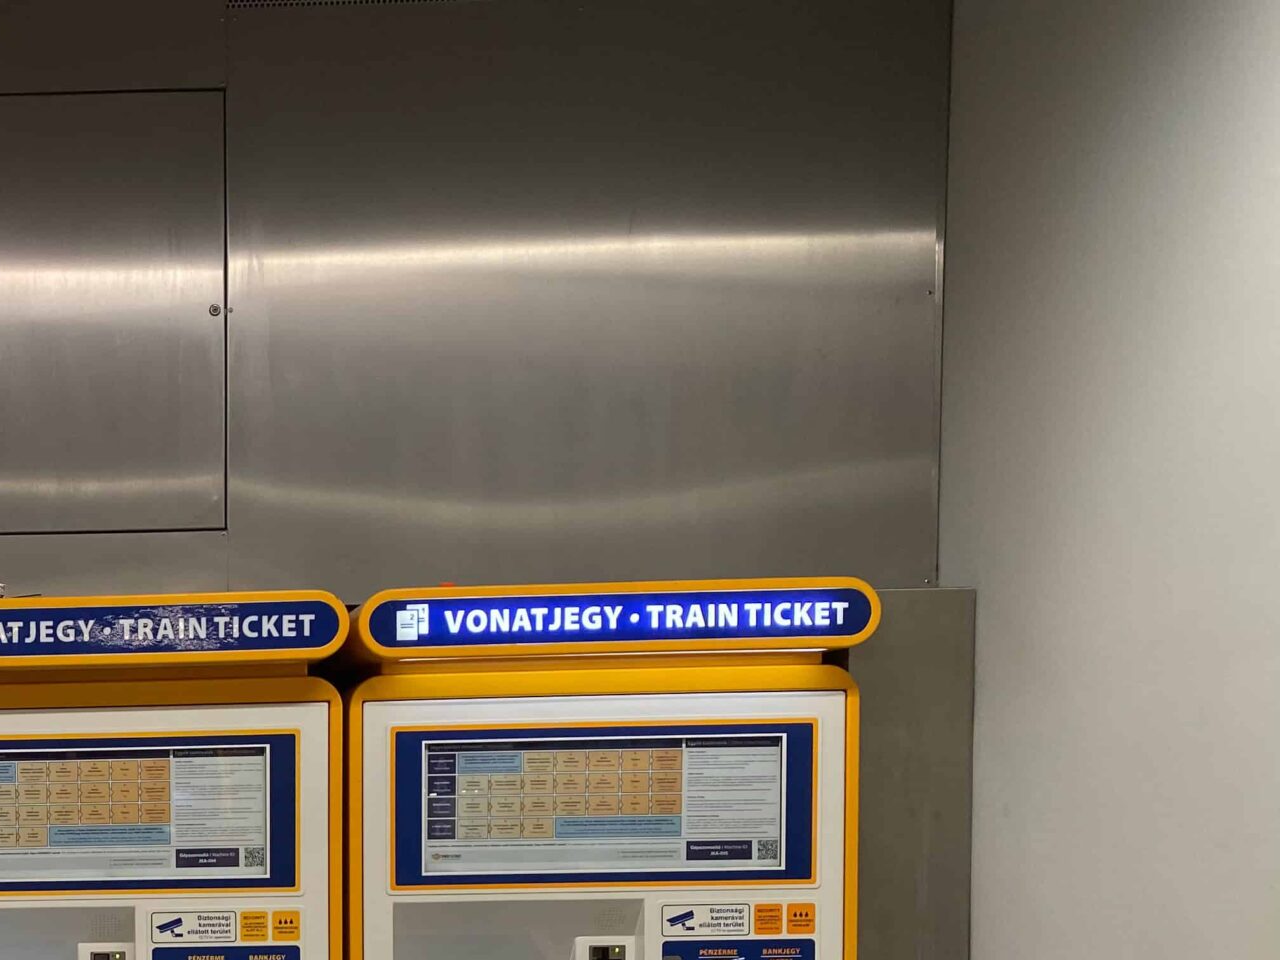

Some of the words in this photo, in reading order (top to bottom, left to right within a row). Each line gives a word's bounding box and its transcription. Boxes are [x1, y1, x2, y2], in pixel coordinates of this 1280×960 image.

[120, 617, 207, 640] TRAIN
[216, 614, 316, 638] TICKET
[444, 606, 624, 634] VONATJEGY
[646, 604, 738, 629] TRAIN
[744, 602, 849, 627] TICKET
